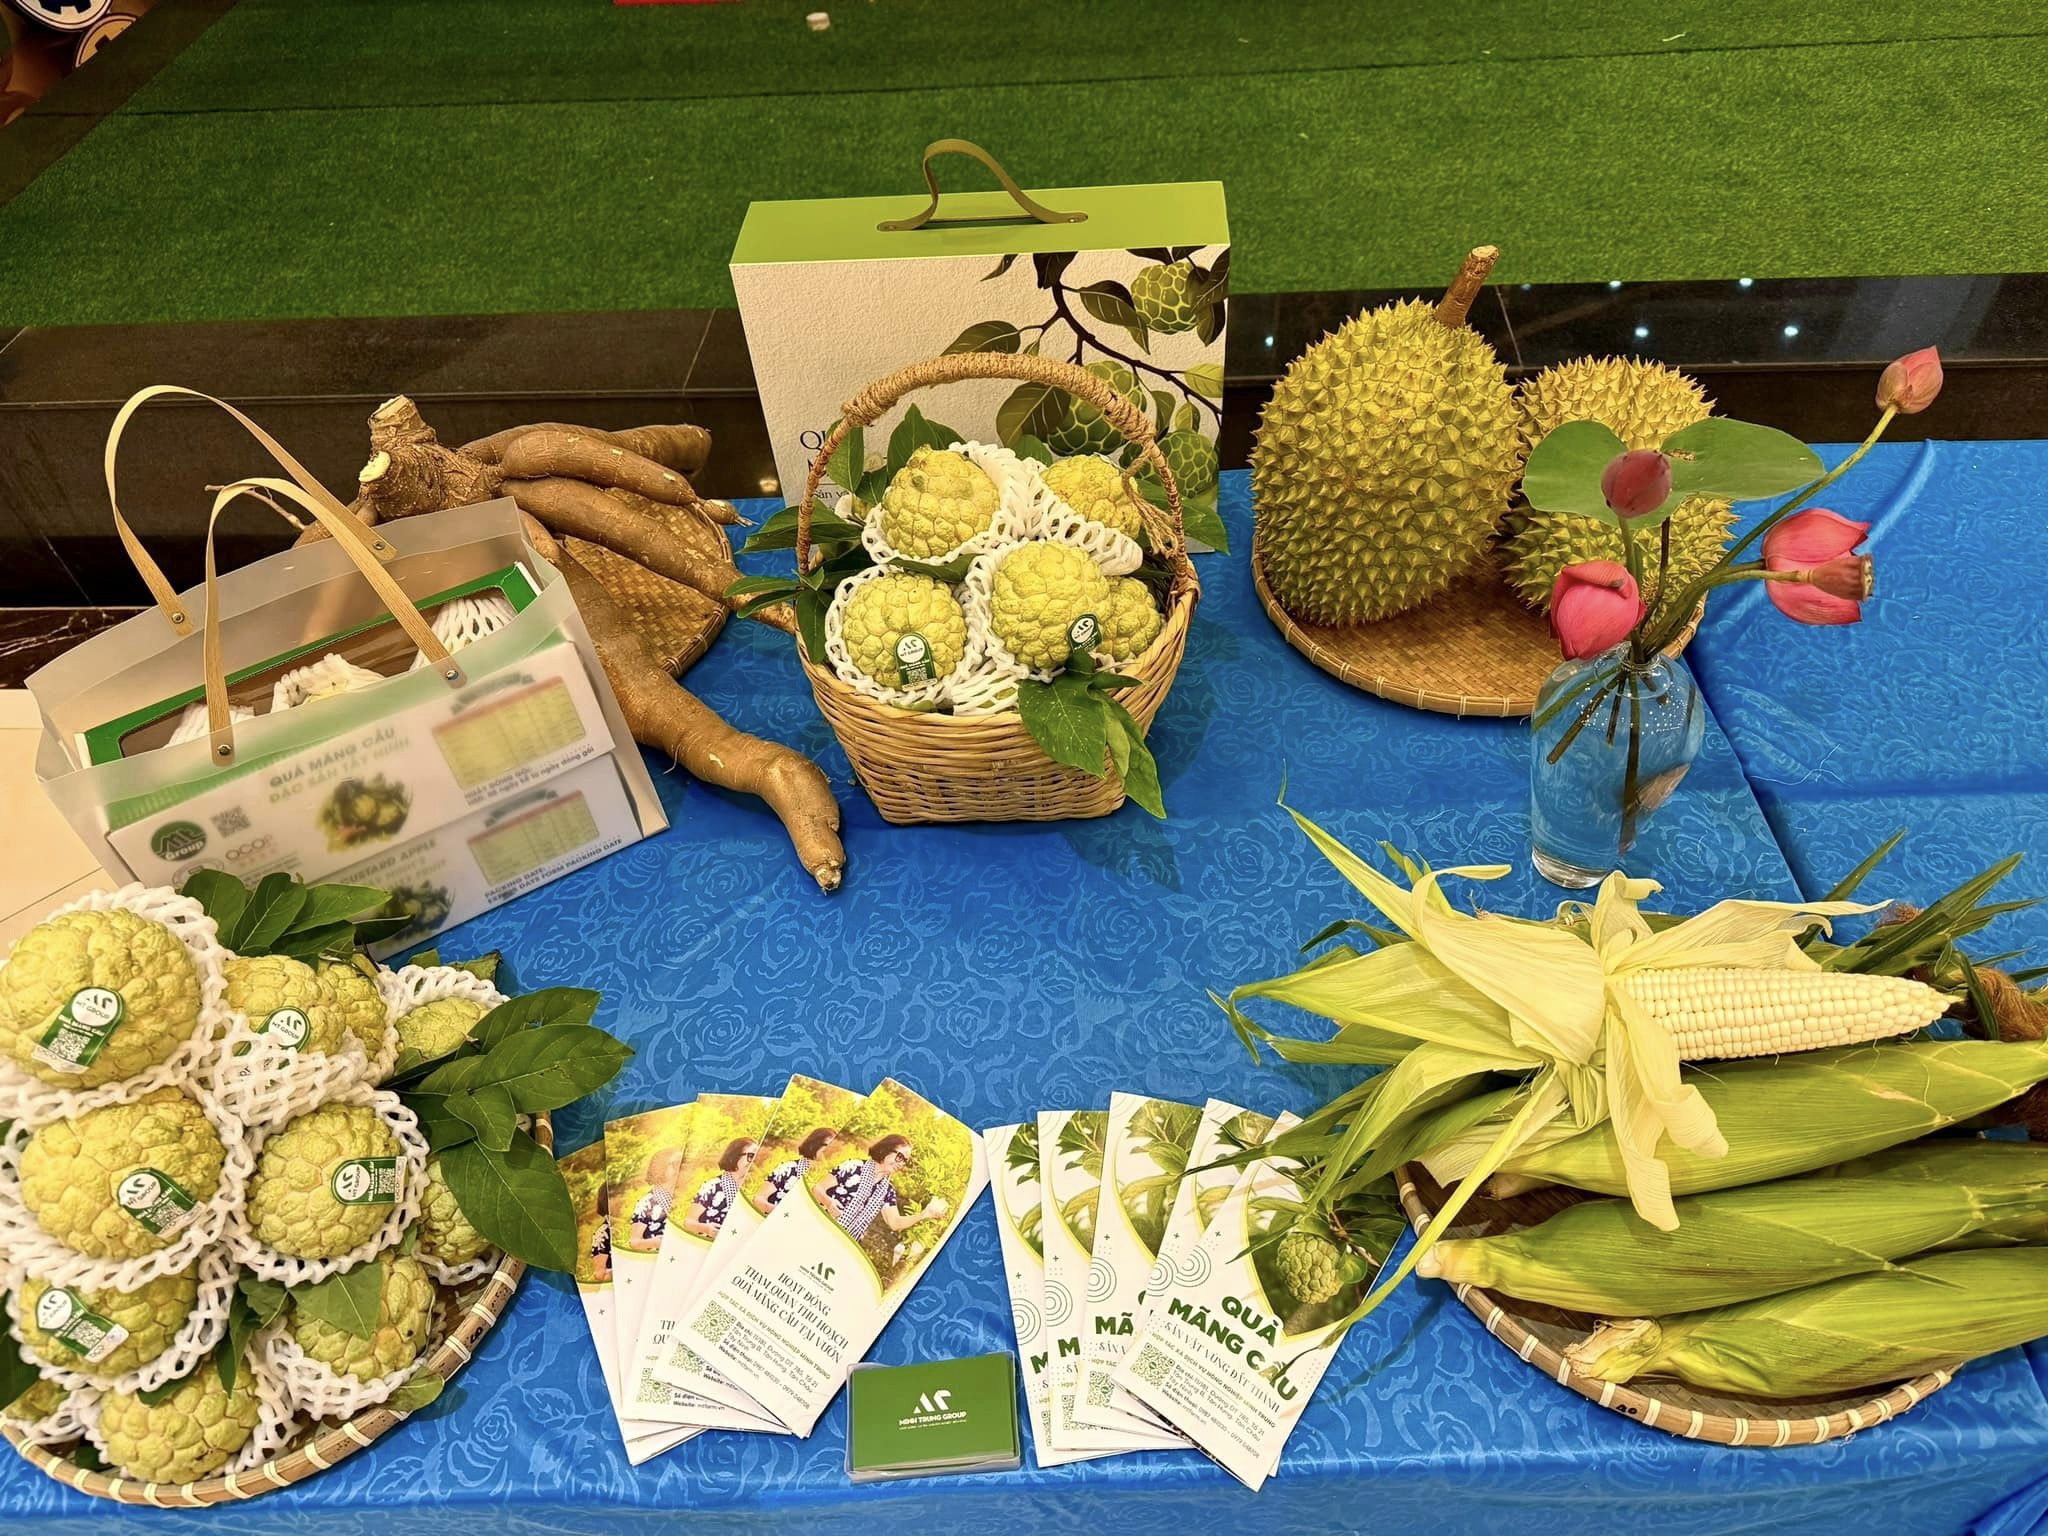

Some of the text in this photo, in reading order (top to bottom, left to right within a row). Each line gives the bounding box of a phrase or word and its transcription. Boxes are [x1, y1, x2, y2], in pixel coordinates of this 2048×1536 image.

[565, 847, 603, 868] PACKING
[603, 837, 623, 850] DATE
[136, 1179, 157, 1201] GROUP
[353, 1166, 361, 1188] GROUP
[733, 1276, 752, 1294] QUẢ
[754, 1289, 779, 1313] MÃNG
[799, 1323, 816, 1341] TẠI
[745, 1265, 772, 1289] THAM
[770, 1285, 794, 1308] QUAN
[798, 1303, 818, 1323] THU
[816, 1320, 849, 1349] HOẠCH
[778, 1273, 804, 1295] HOẠT
[803, 1291, 831, 1316] ĐỘNG
[746, 1311, 759, 1323] DỊCH
[767, 1327, 782, 1340] NÔNG
[1095, 1312, 1134, 1336] MÃ
[1221, 1295, 1280, 1347] QUẢ
[1168, 1297, 1299, 1401] MÃNG CẦU
[1184, 1354, 1198, 1367] DỊCH
[1206, 1371, 1222, 1385] NÔNG
[1258, 1411, 1275, 1428] TRUNG
[1230, 1369, 1248, 1386] ĐẤT
[898, 1417, 917, 1425] MINH
[918, 1414, 941, 1423] TRUNG
[942, 1410, 967, 1420] GROUP
